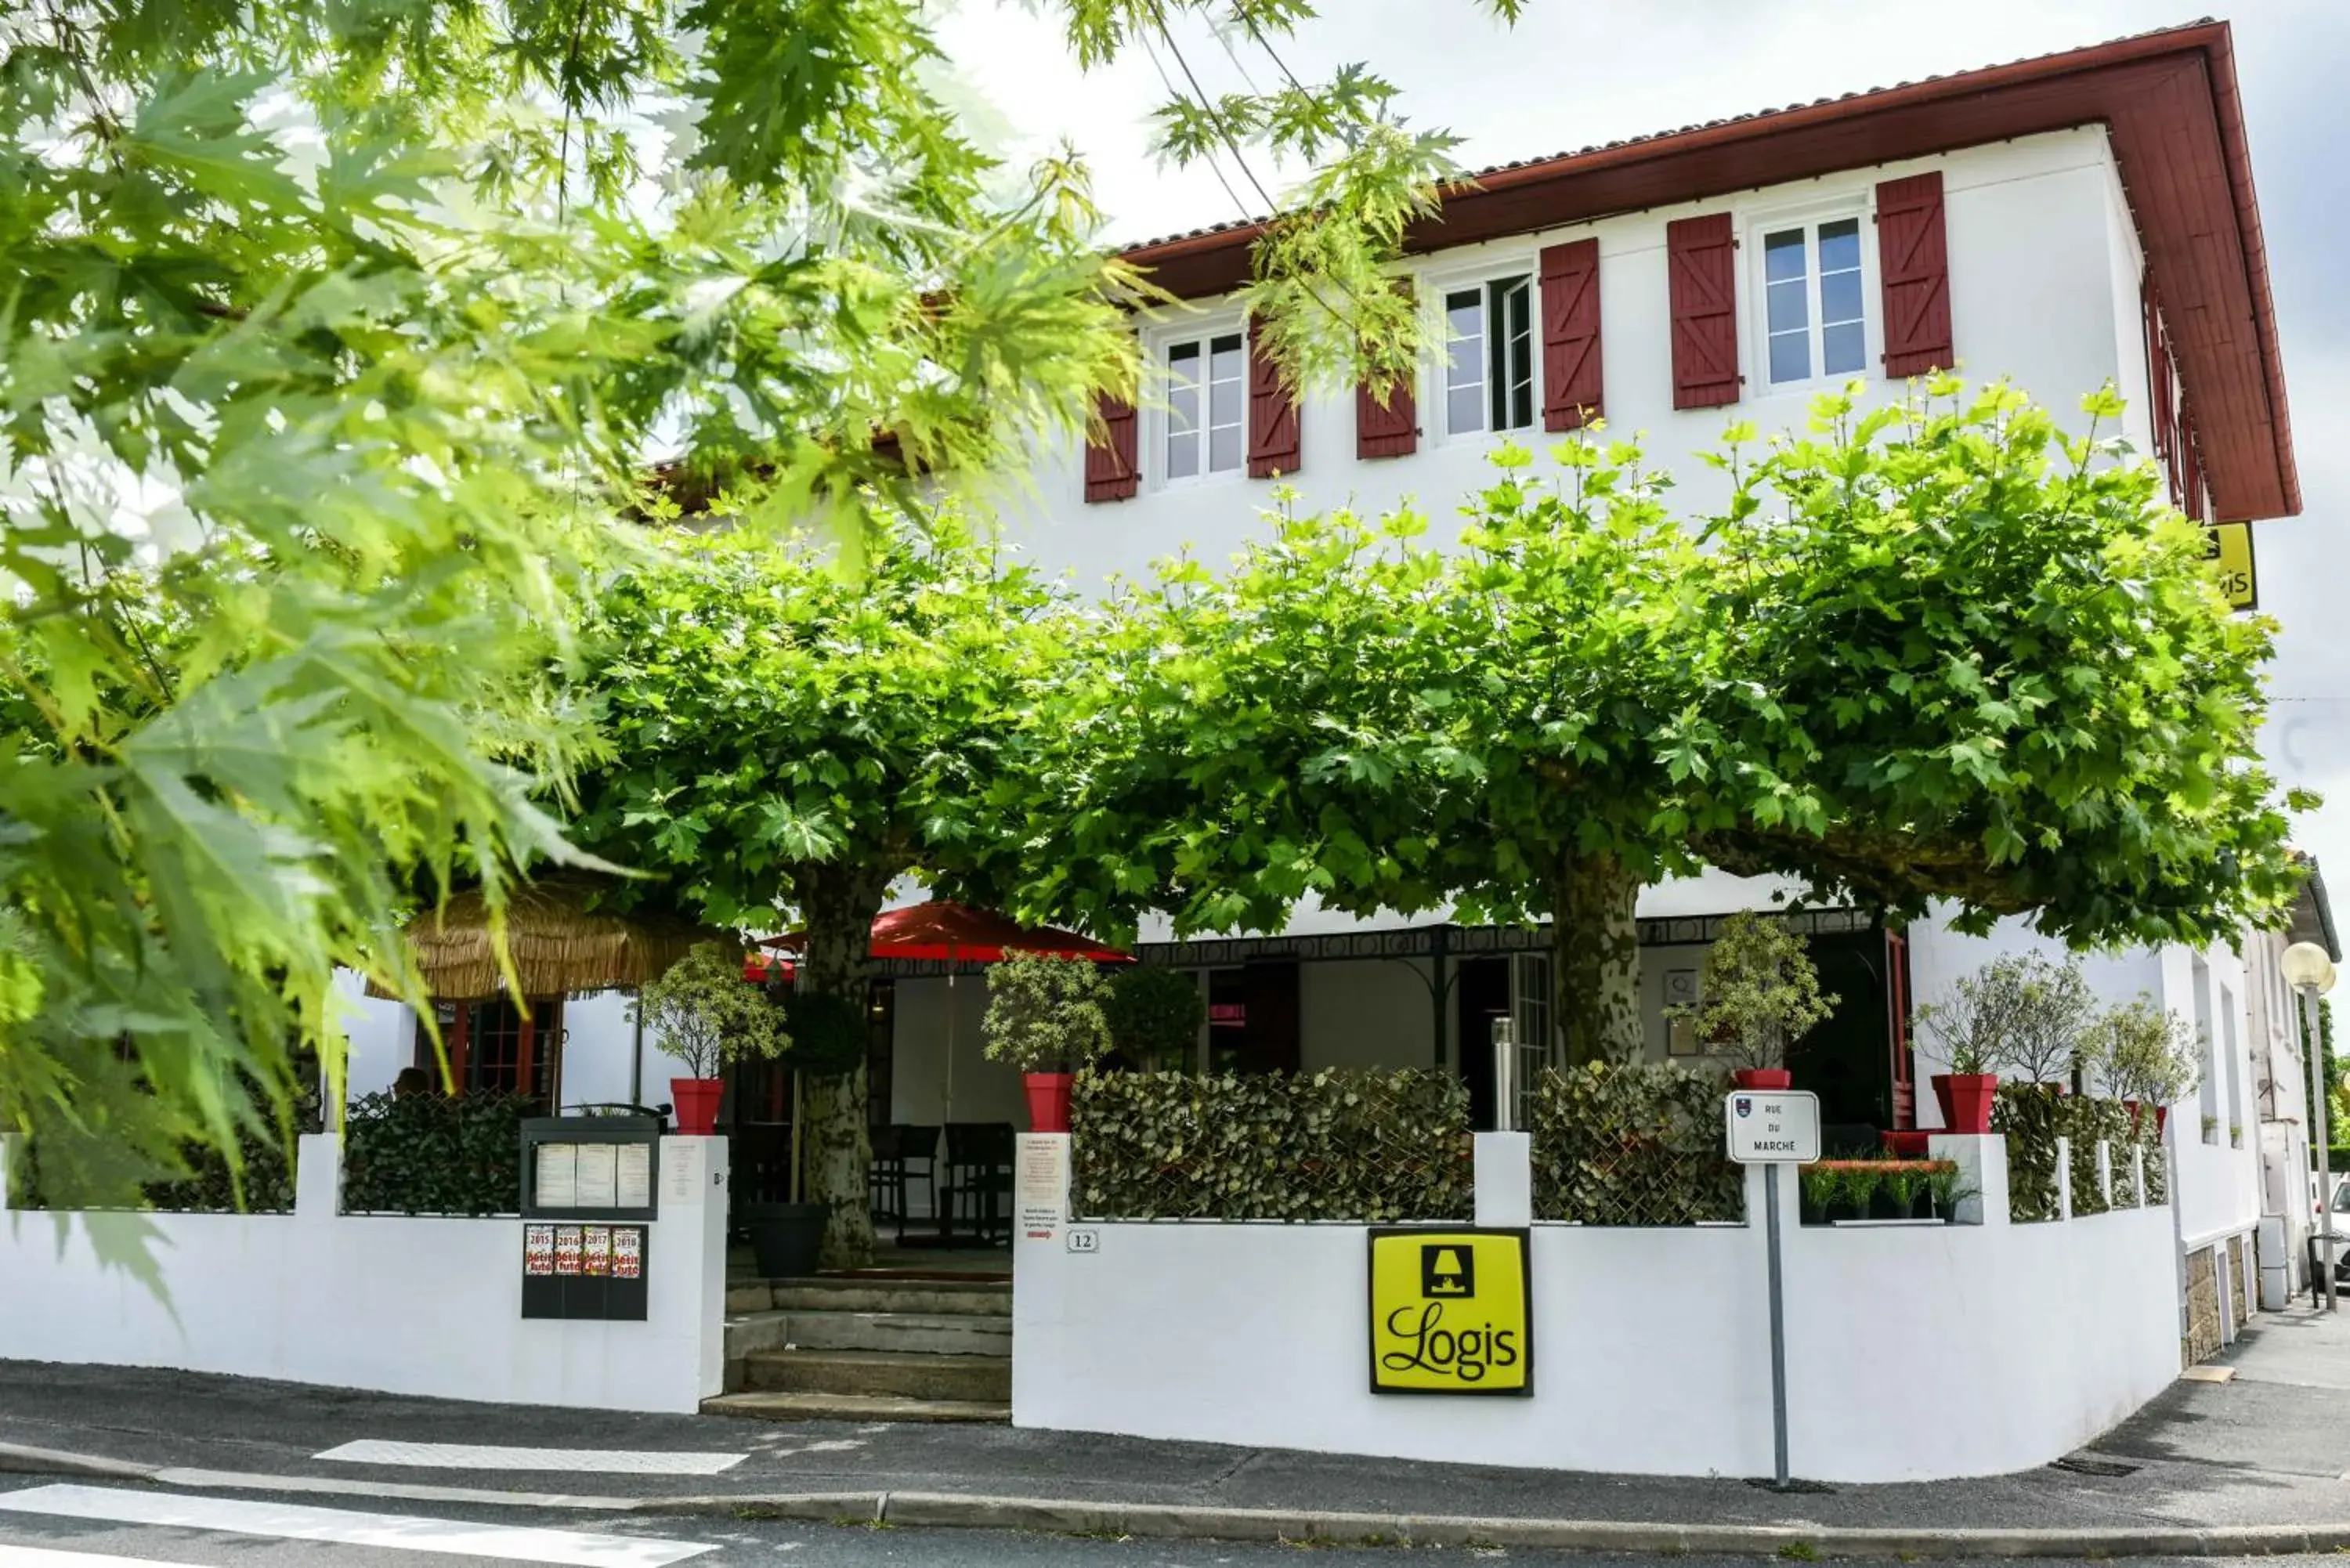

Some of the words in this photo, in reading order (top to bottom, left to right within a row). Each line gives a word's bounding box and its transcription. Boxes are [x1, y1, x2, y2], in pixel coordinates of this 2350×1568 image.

[1765, 1104, 1782, 1114] RUE
[1768, 1123, 1781, 1133] DU
[530, 1235, 549, 1245] 2015
[559, 1237, 579, 1246] 2016
[587, 1235, 607, 1245] 2017
[1076, 1235, 1091, 1247] 12
[1383, 1301, 1517, 1382] Logis
